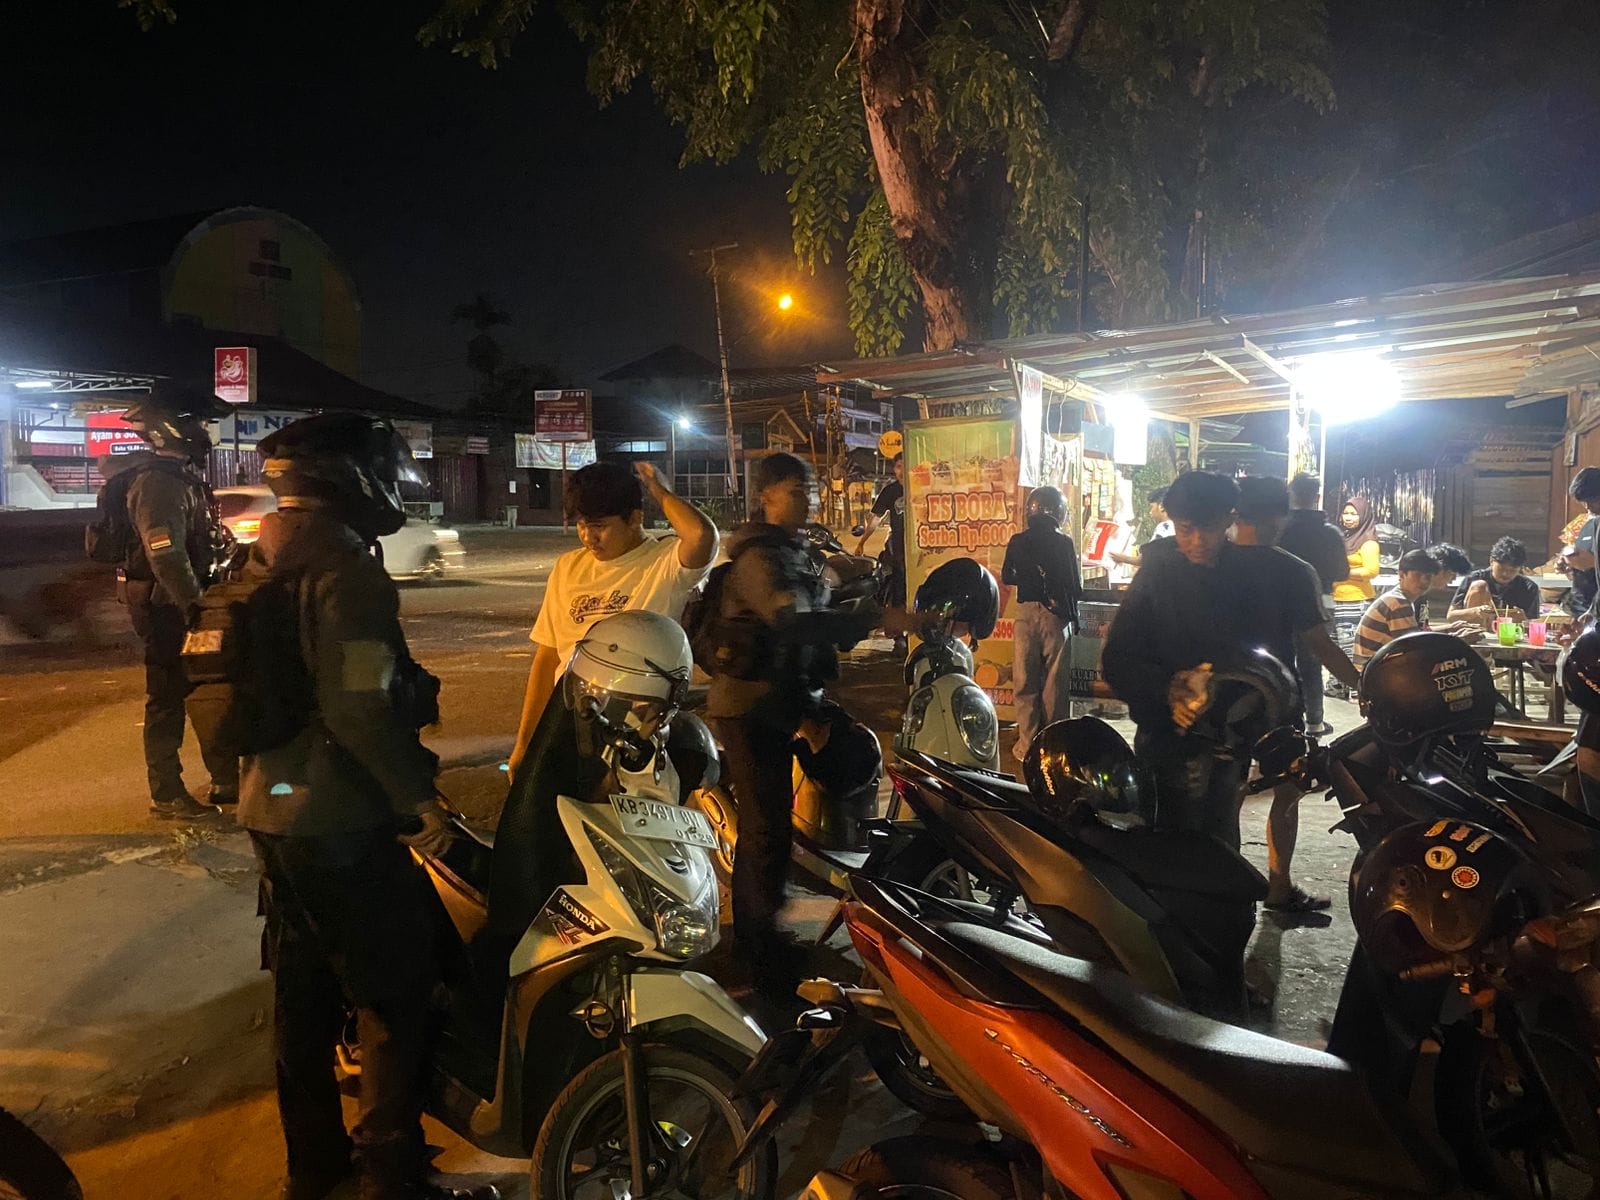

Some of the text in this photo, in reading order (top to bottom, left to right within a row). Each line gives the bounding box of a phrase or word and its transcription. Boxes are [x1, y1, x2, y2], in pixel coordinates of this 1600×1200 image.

[91, 432, 112, 443] Ayam
[928, 491, 1008, 523] ES BOBA
[918, 525, 958, 547] Serba
[617, 797, 638, 815] KB
[559, 894, 597, 931] HONDA
